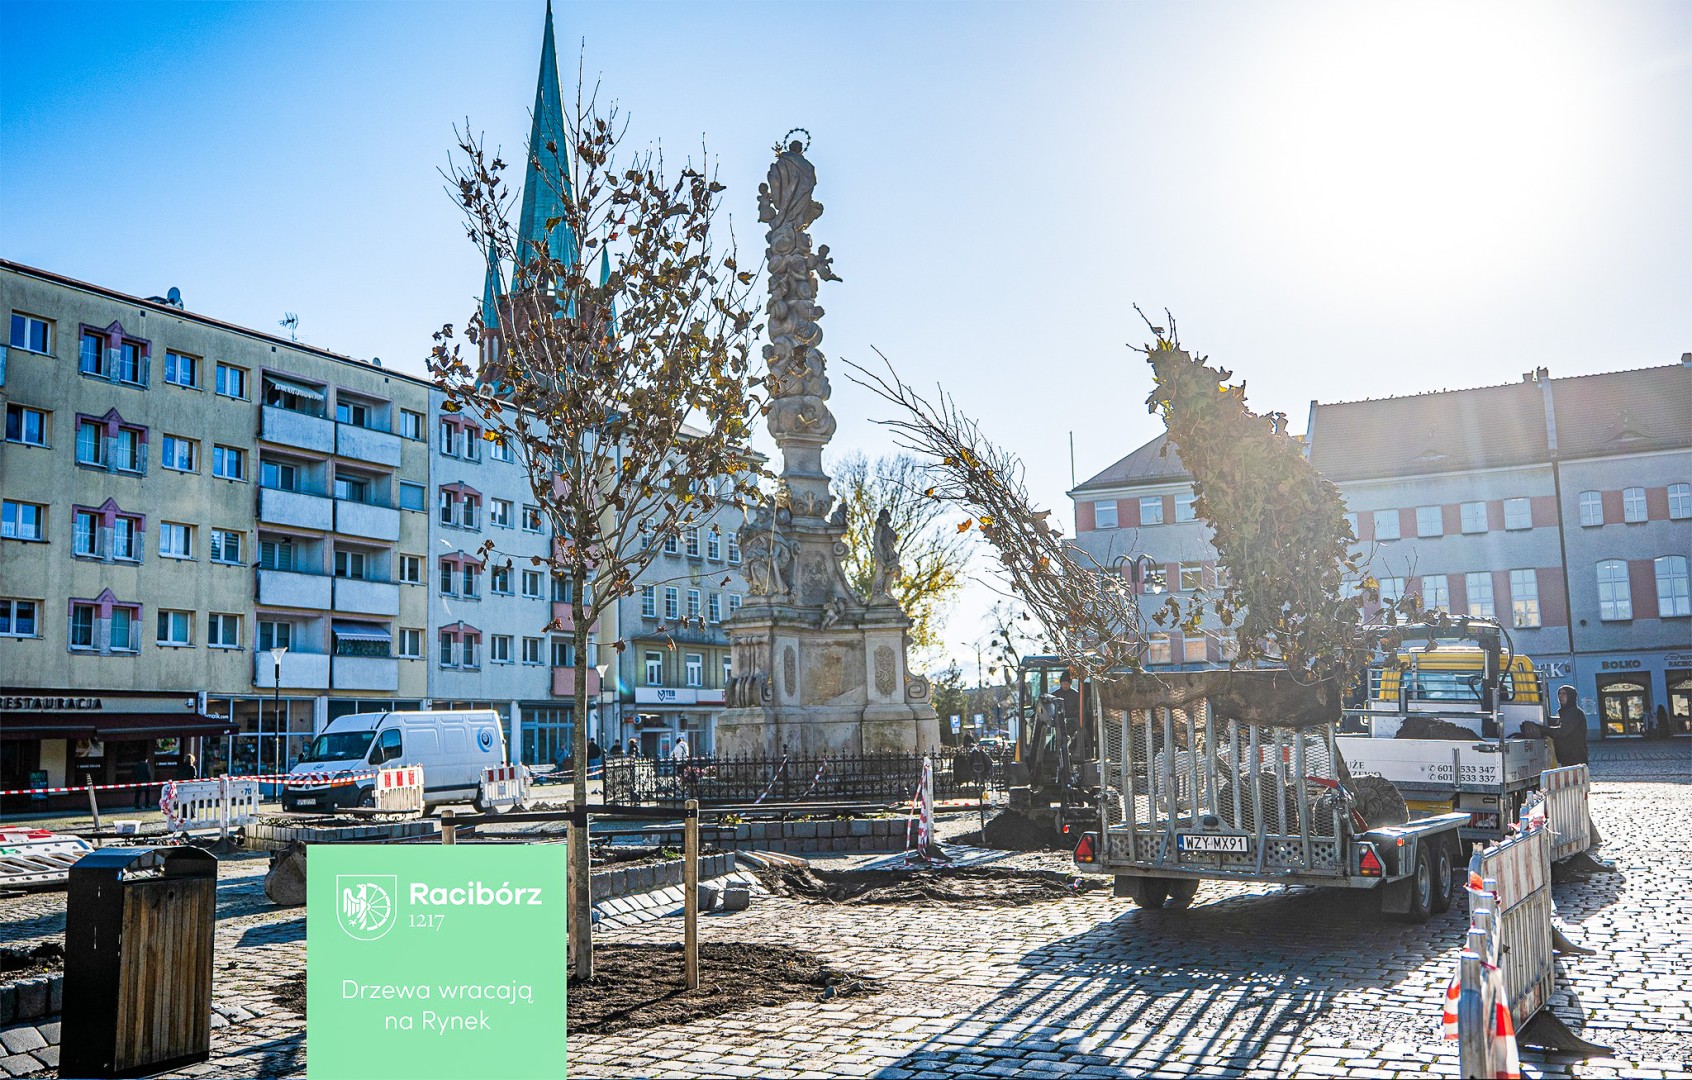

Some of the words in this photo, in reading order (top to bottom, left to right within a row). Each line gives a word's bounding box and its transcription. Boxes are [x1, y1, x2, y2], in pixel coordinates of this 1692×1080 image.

[1601, 659, 1641, 669] BOLKO
[0, 697, 103, 710] ESTAURACJA
[1437, 764, 1454, 773] 601
[1460, 765, 1477, 774] 533
[1478, 765, 1496, 774] 347
[1437, 773, 1454, 781] 601
[1460, 774, 1477, 782] 533
[1478, 774, 1496, 783] 337
[244, 787, 252, 796] 70
[1186, 836, 1209, 850] WZY
[1213, 837, 1243, 851] MX91
